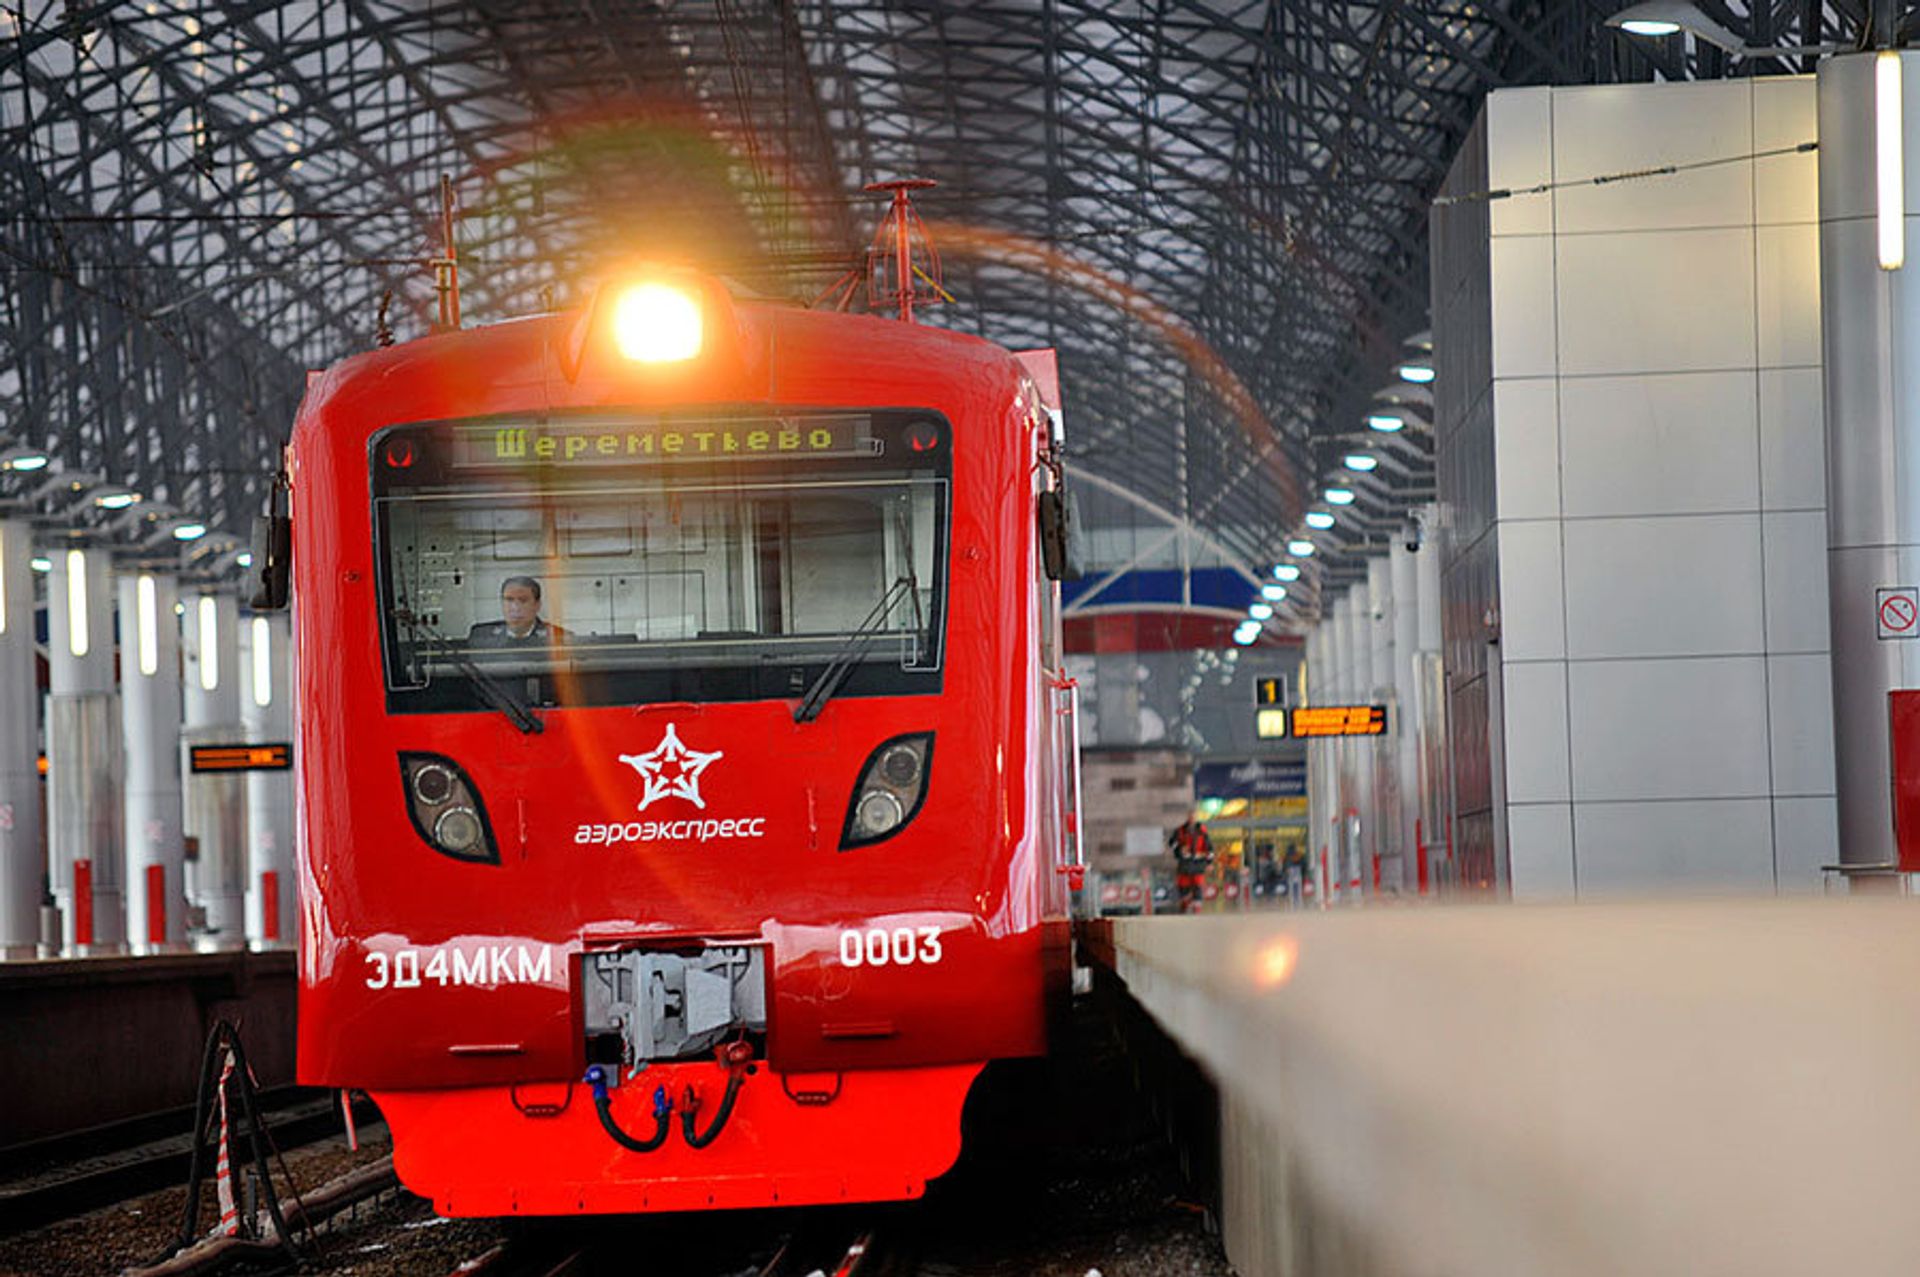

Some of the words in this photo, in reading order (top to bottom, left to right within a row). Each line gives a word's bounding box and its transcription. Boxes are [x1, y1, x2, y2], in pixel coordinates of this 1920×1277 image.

[495, 428, 832, 458] Шереметьево
[1264, 679, 1276, 704] 1
[574, 817, 765, 846] аэроэкспресс
[364, 945, 553, 989] ЭД4МКМ
[839, 927, 942, 967] 0003
